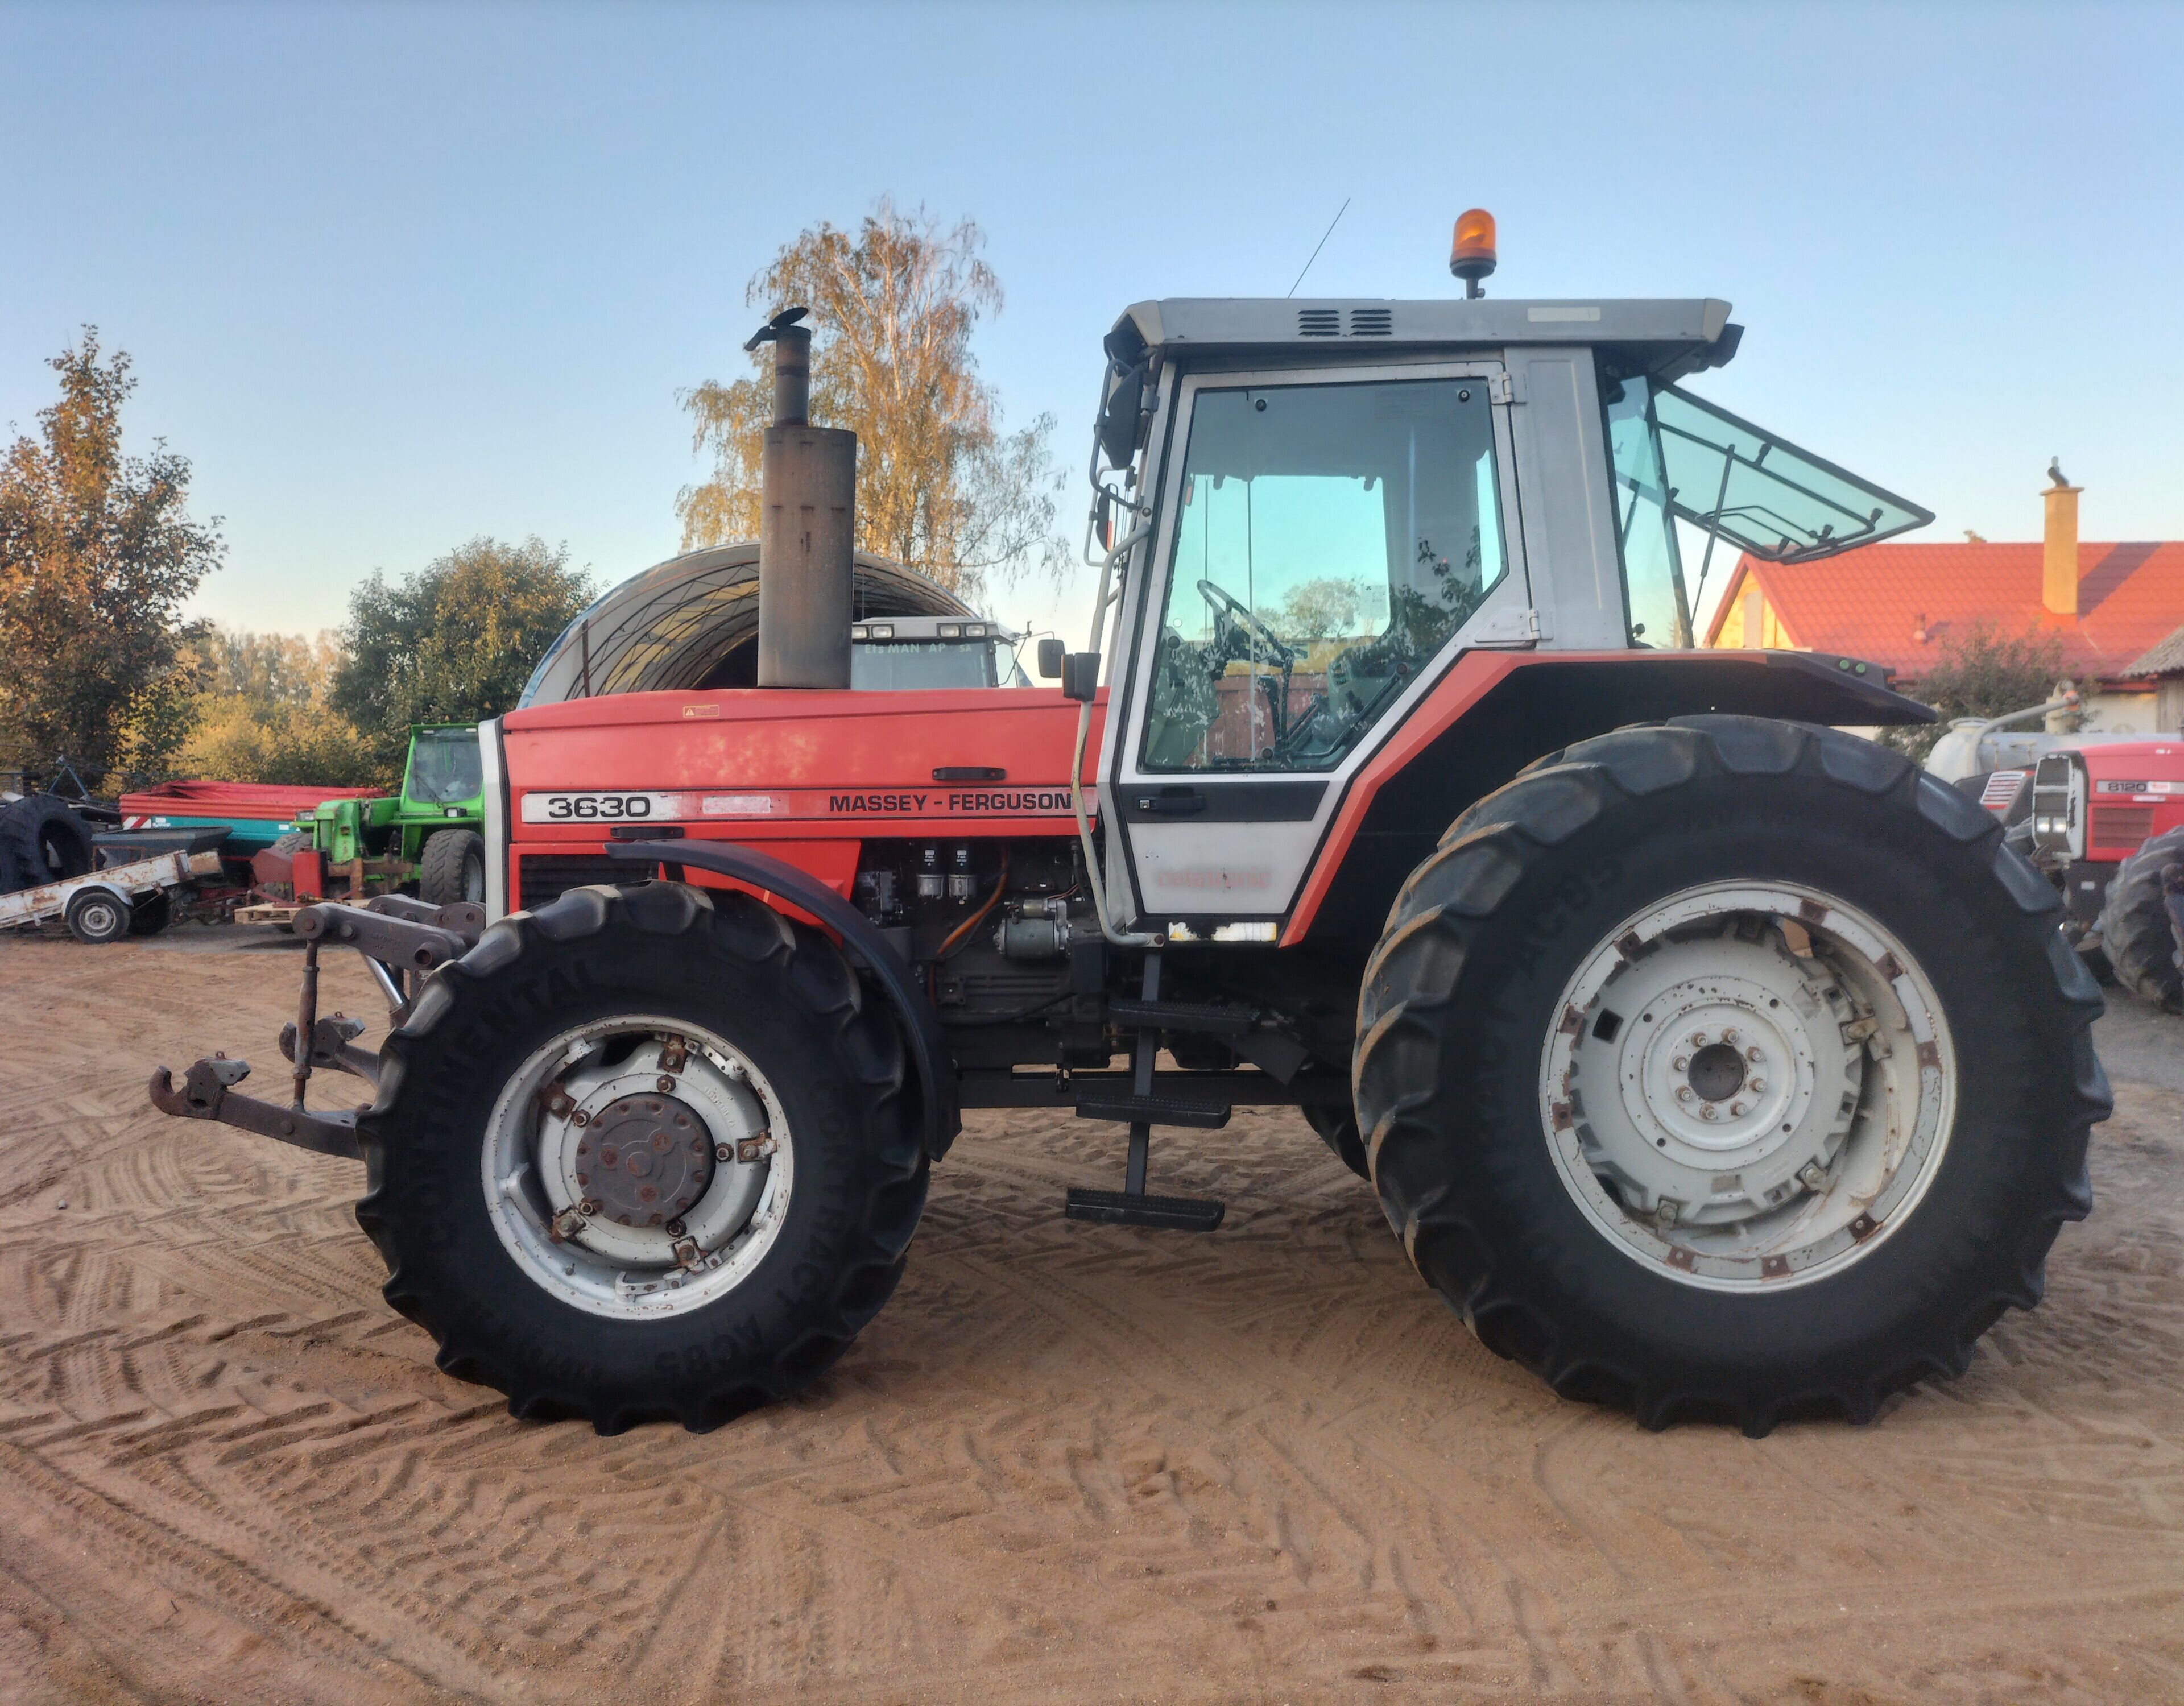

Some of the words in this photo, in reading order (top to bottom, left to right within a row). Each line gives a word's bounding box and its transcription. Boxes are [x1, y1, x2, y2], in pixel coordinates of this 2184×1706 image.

[2108, 782, 2146, 792] 8120
[548, 797, 651, 818] 3630
[829, 794, 927, 811] MASSEY
[949, 793, 1072, 810] FERGUSON
[412, 958, 601, 1254] CONTINENTAL
